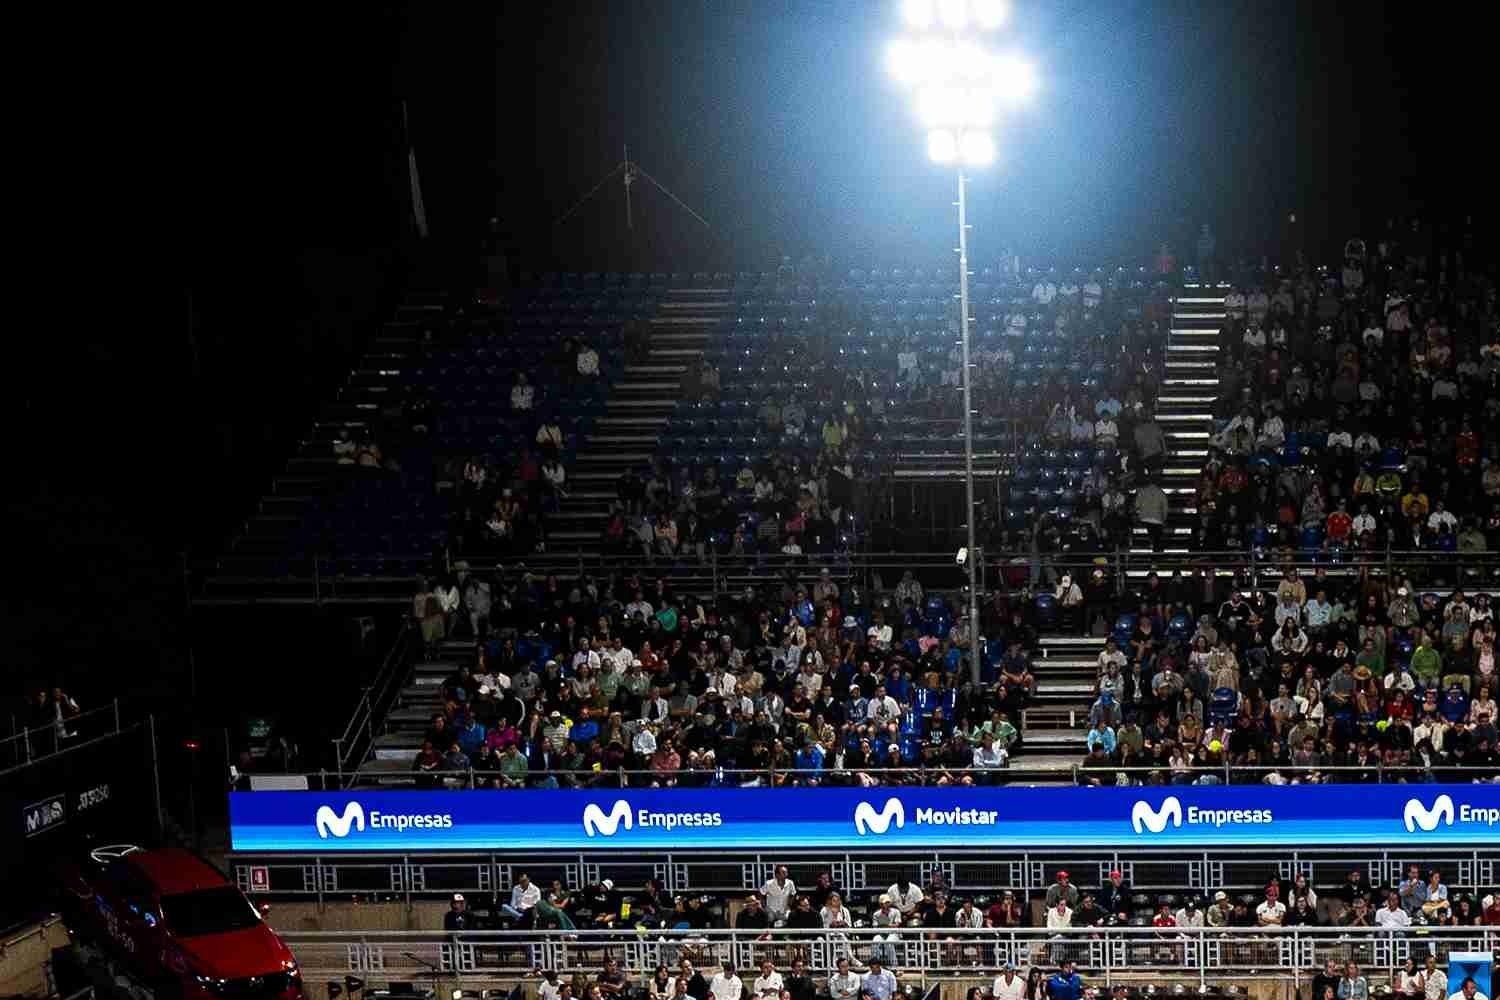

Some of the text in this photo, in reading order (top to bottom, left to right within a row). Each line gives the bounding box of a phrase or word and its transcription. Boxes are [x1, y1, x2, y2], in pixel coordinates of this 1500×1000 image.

[370, 810, 452, 831] Empresas
[639, 809, 721, 830] Empresas
[916, 806, 997, 824] Movistar
[1188, 806, 1272, 826] Empresas
